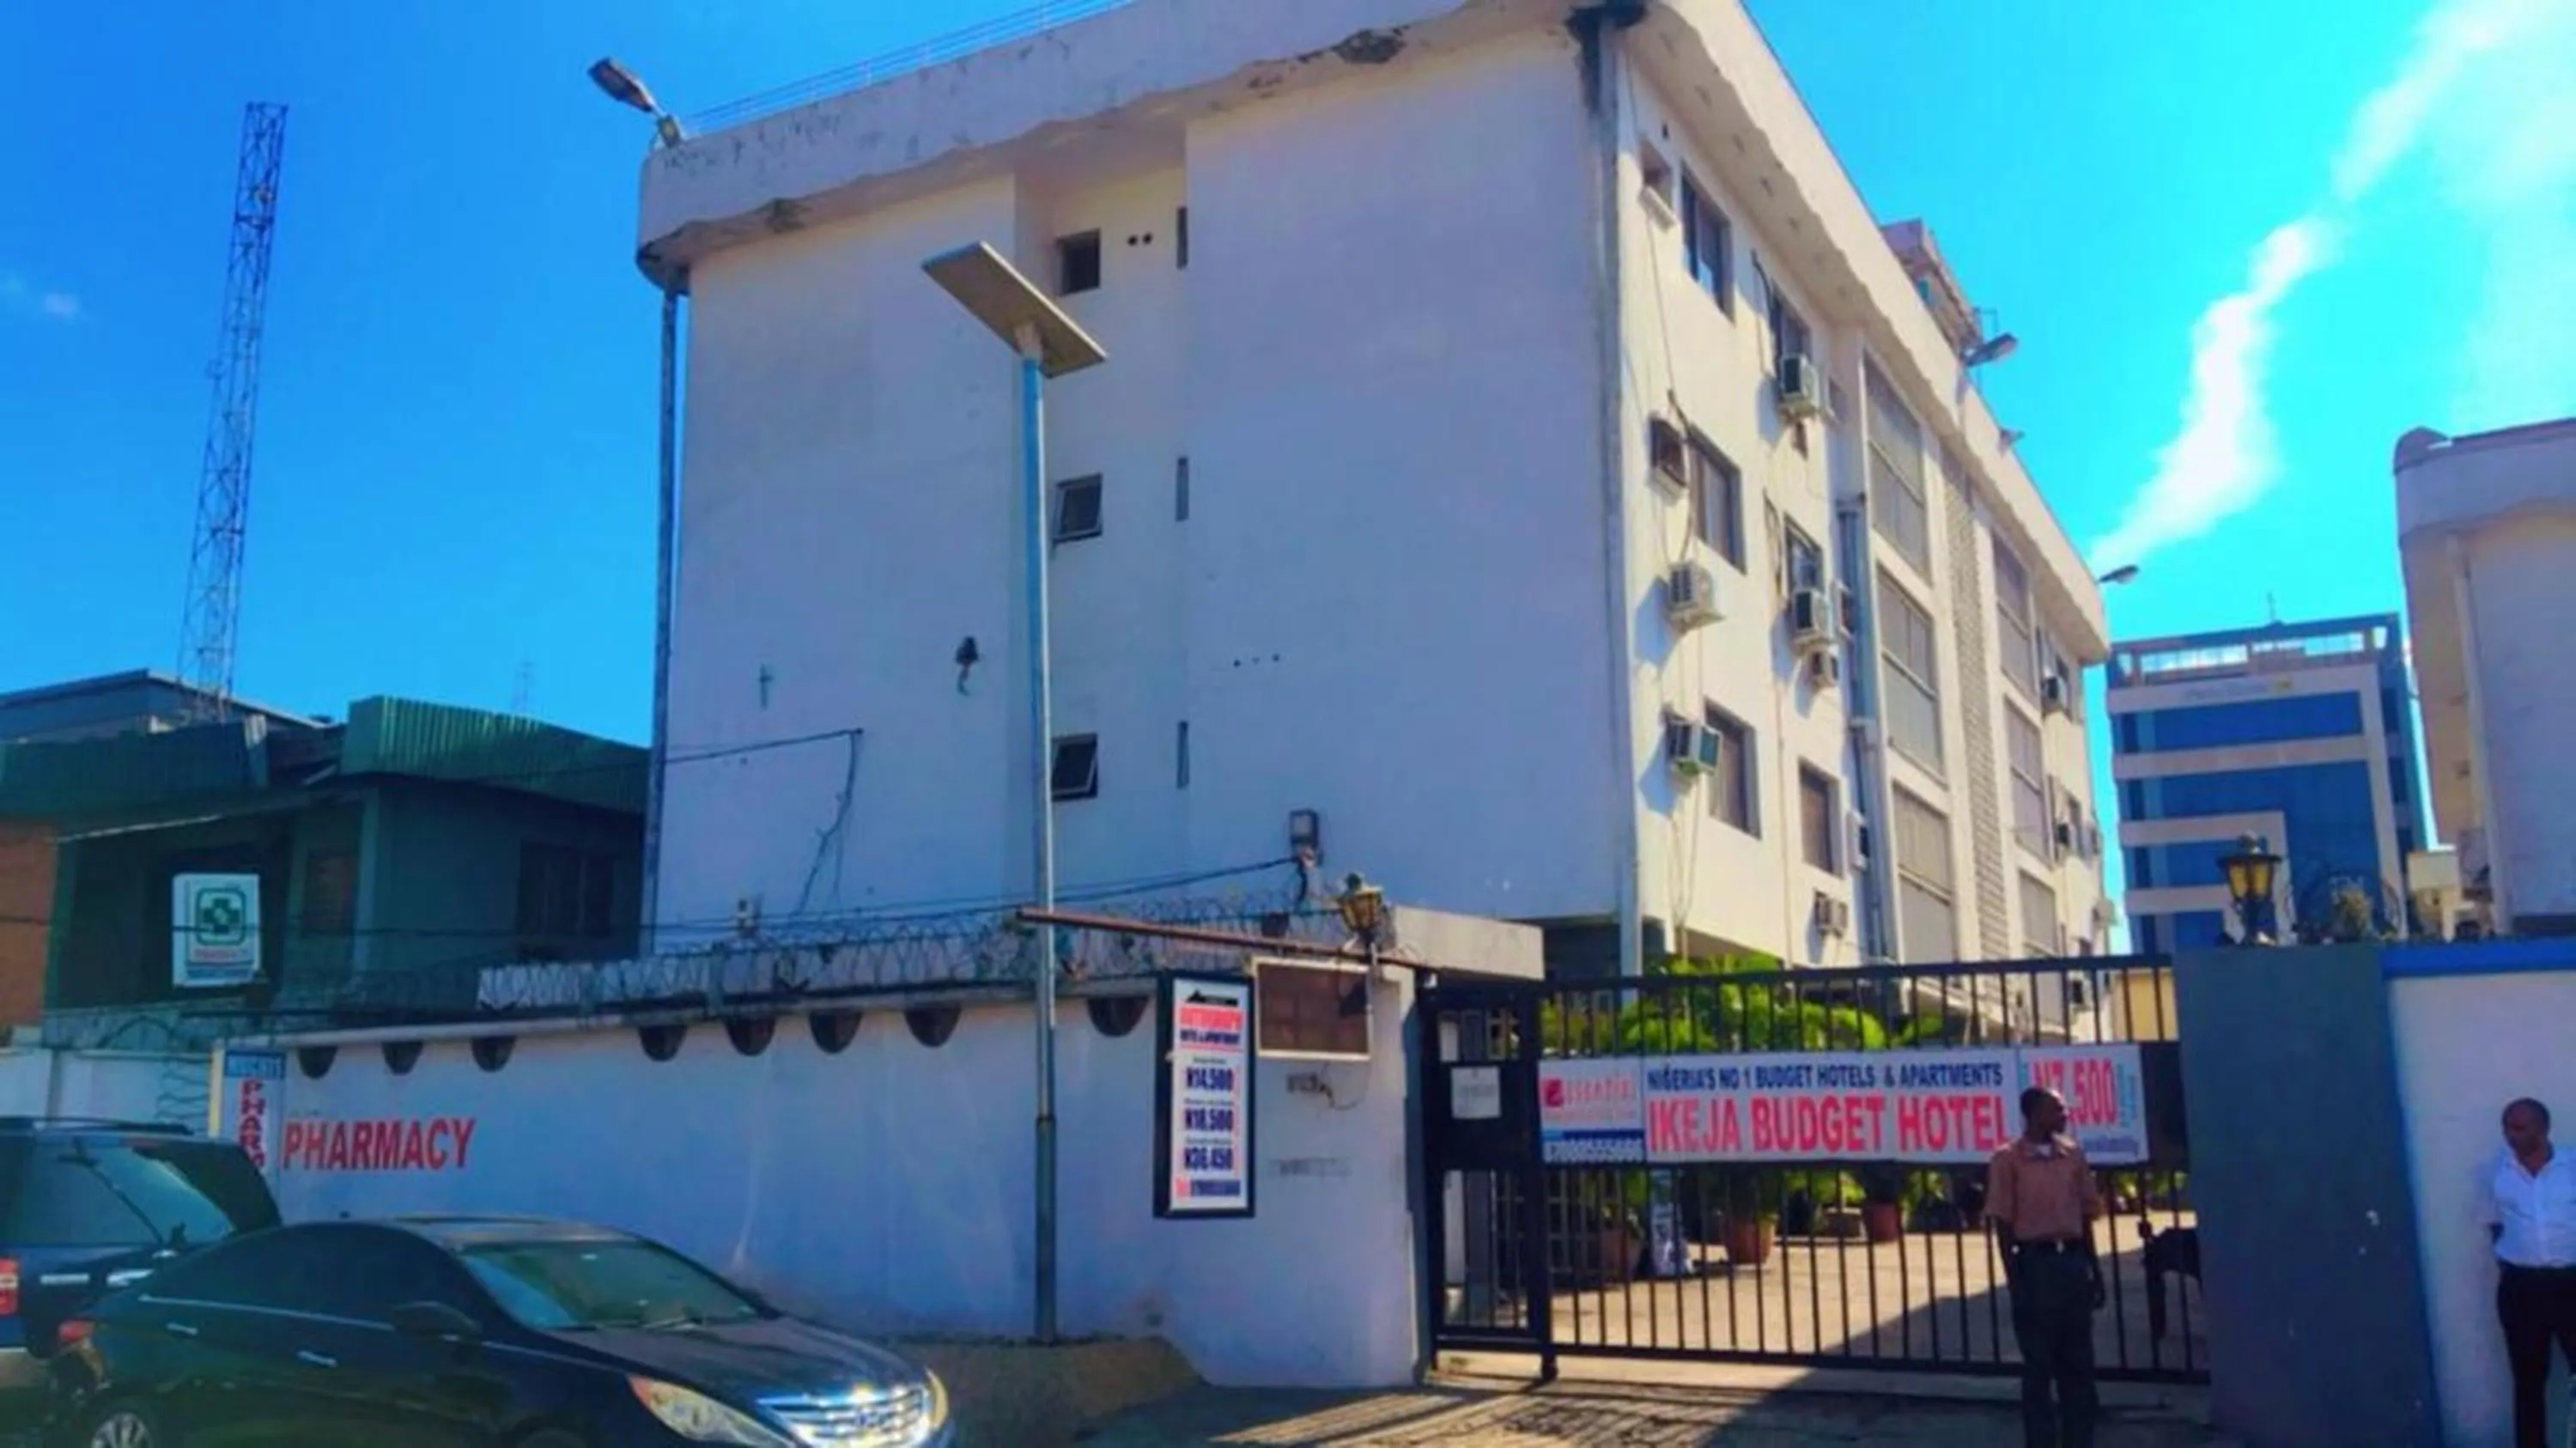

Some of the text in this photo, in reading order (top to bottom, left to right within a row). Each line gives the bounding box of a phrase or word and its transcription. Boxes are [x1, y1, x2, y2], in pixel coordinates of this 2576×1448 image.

[1719, 1068, 1741, 1089] NO
[1755, 1065, 1813, 1089] BUDGET
[1817, 1064, 1875, 1088] HOTELS
[1884, 1065, 1896, 1087] &
[1899, 1062, 2004, 1087] APARTMENTS
[282, 1118, 476, 1171] PHARMACY
[1649, 1094, 2009, 1154] IKEJA BUDGET HOTEL
